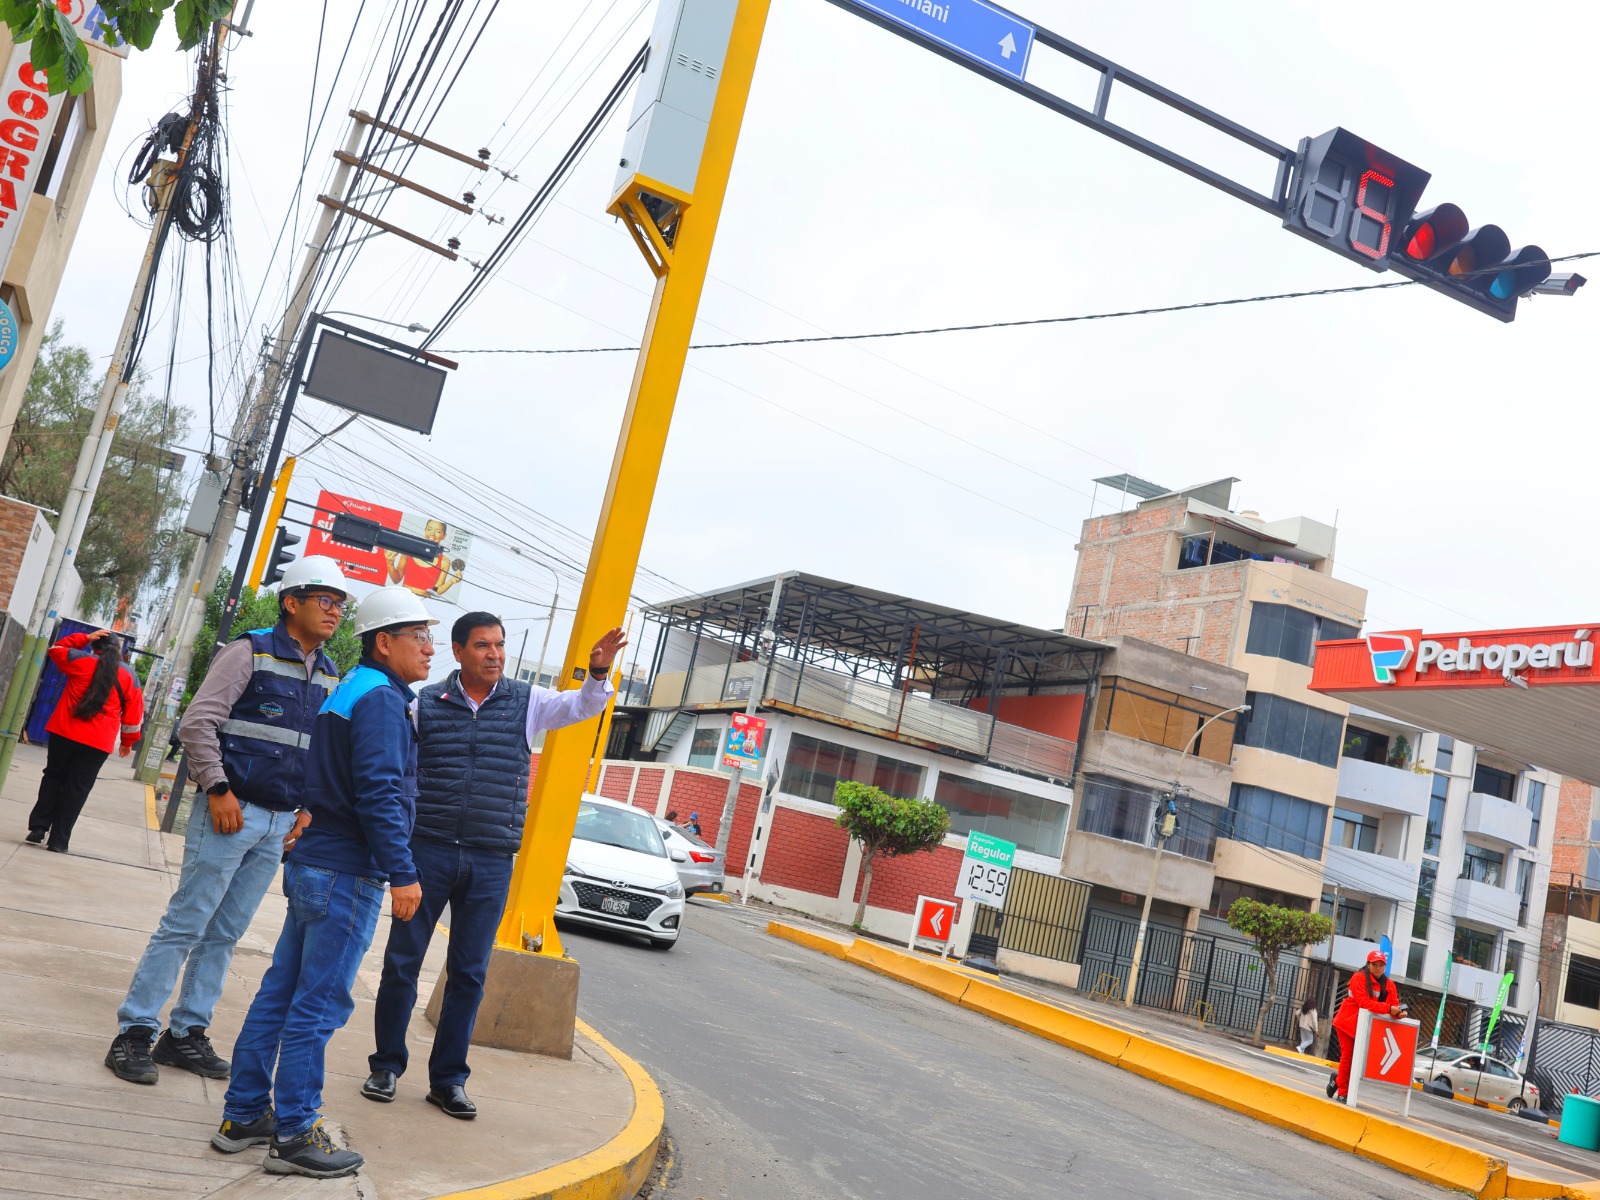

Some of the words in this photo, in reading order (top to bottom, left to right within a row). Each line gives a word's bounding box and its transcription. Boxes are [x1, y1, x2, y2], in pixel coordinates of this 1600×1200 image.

[1416, 628, 1594, 677] Petroperú
[970, 841, 1011, 862] Regular
[968, 864, 1008, 897] 12.59
